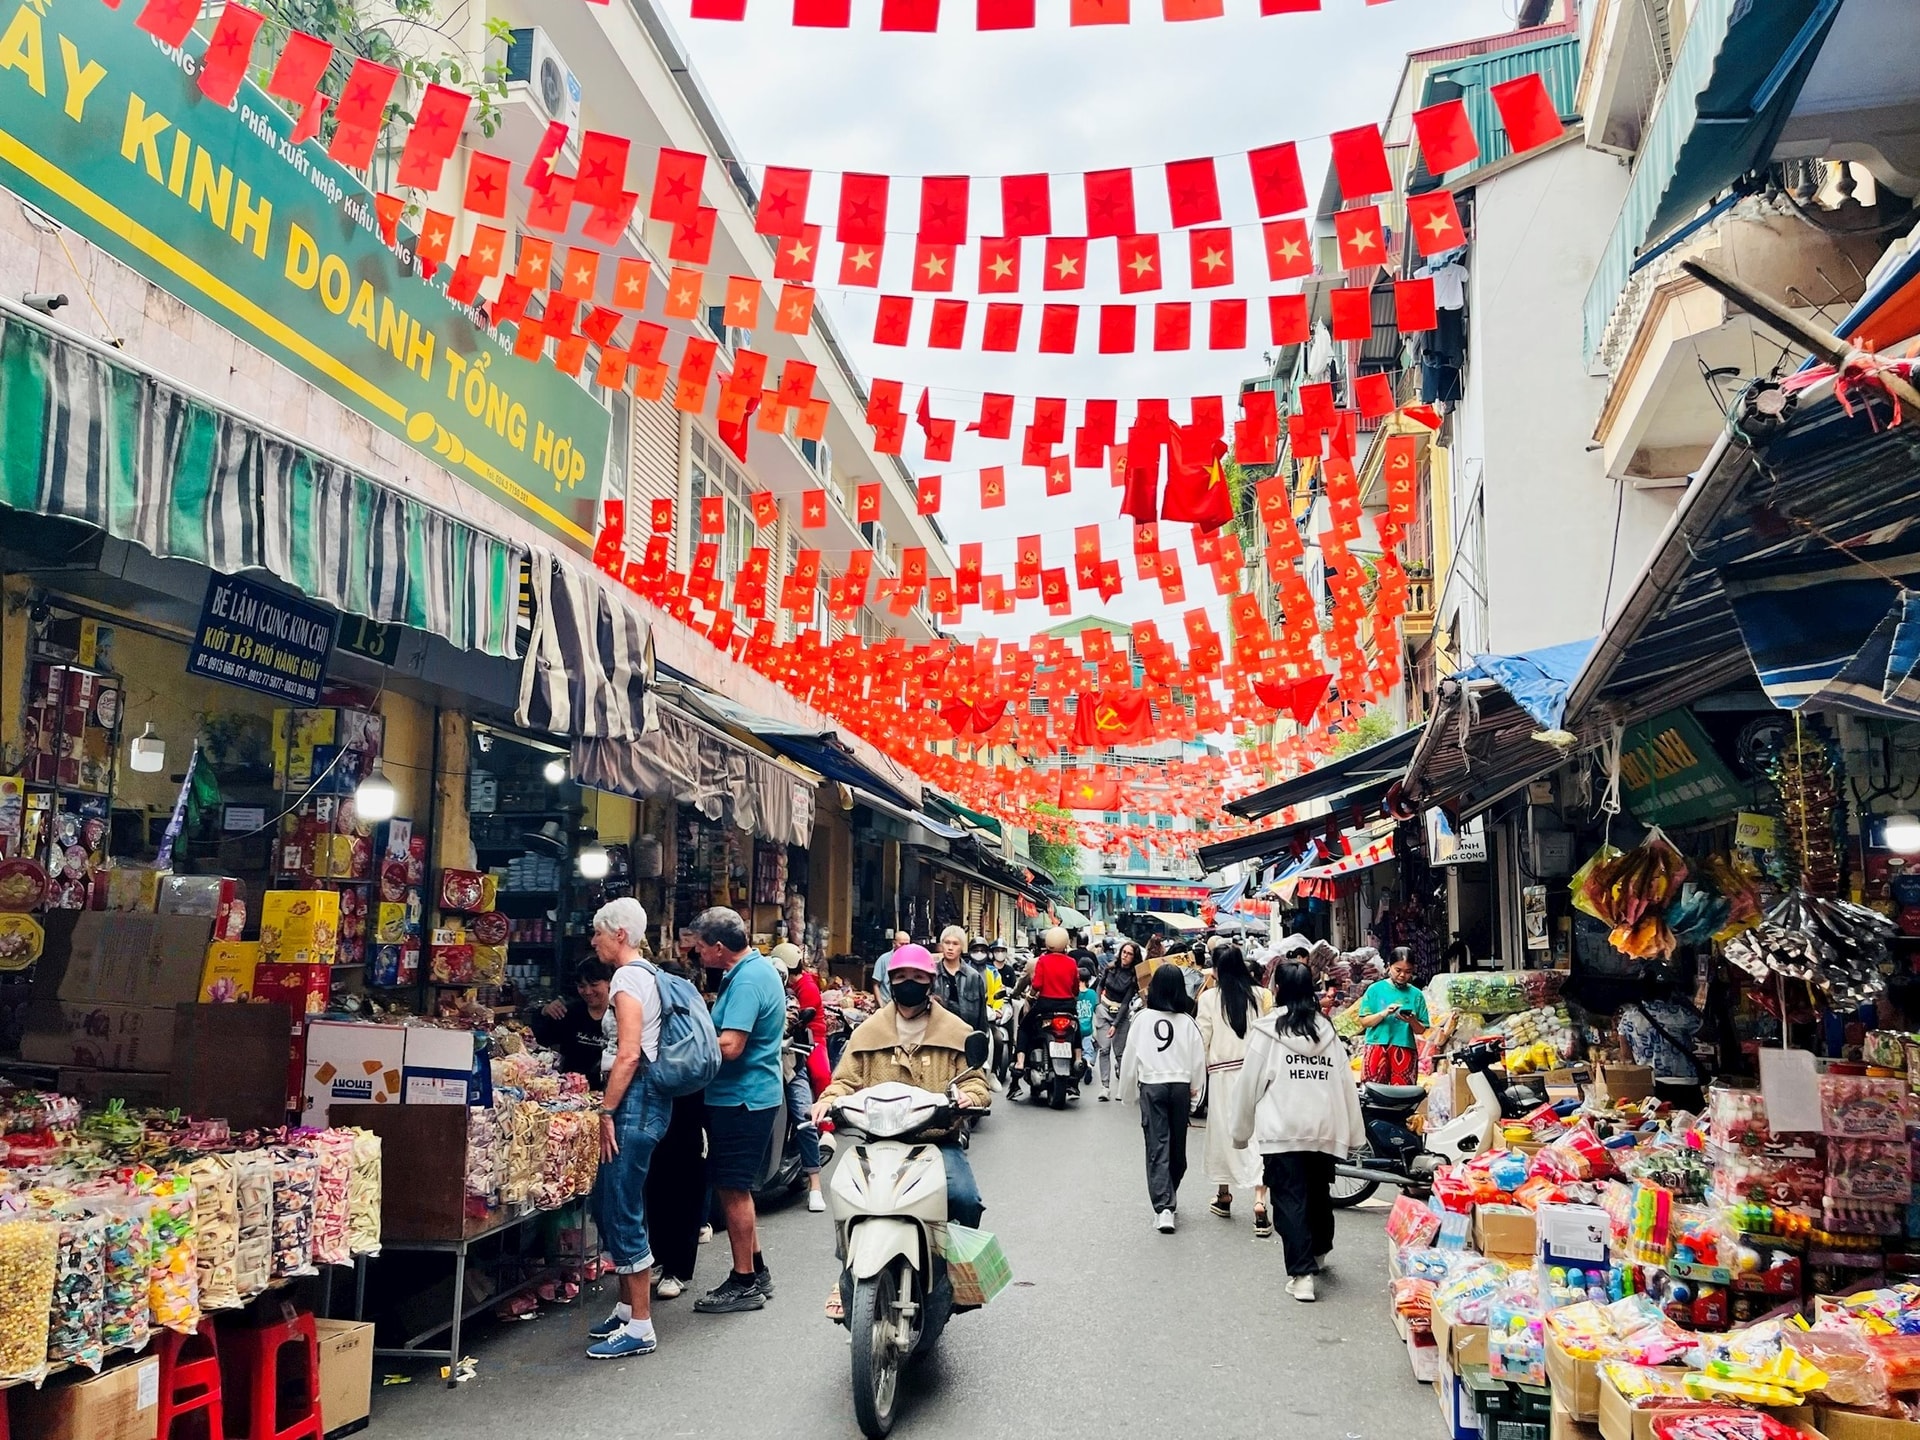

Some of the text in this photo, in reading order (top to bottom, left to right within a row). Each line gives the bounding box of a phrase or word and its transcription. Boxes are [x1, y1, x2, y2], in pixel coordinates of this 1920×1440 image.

[240, 104, 277, 149] PHẦN
[278, 137, 311, 176] XUẤT
[311, 166, 343, 204] NHẬP
[344, 195, 374, 232] KHẨU
[375, 222, 411, 265] LNG
[498, 332, 514, 357] NỘI
[120, 91, 273, 260] KINH
[284, 222, 436, 382] DOANH
[445, 346, 528, 452] TỔNG
[532, 420, 586, 493] HỢP
[211, 582, 232, 618] BÉ
[231, 588, 258, 628] LÂM
[256, 601, 290, 640] (CUNG
[289, 612, 310, 646] KIM
[203, 624, 231, 652] KIỐT
[228, 632, 254, 660] 13
[252, 641, 277, 667] PHỐ
[274, 648, 300, 676] HÀNG
[351, 617, 388, 656] 13
[207, 657, 224, 673] 0915
[261, 671, 270, 685] 77
[1441, 853, 1458, 861] NG
[1153, 1019, 1174, 1052] 9
[1285, 1054, 1334, 1068] OFFICIAL
